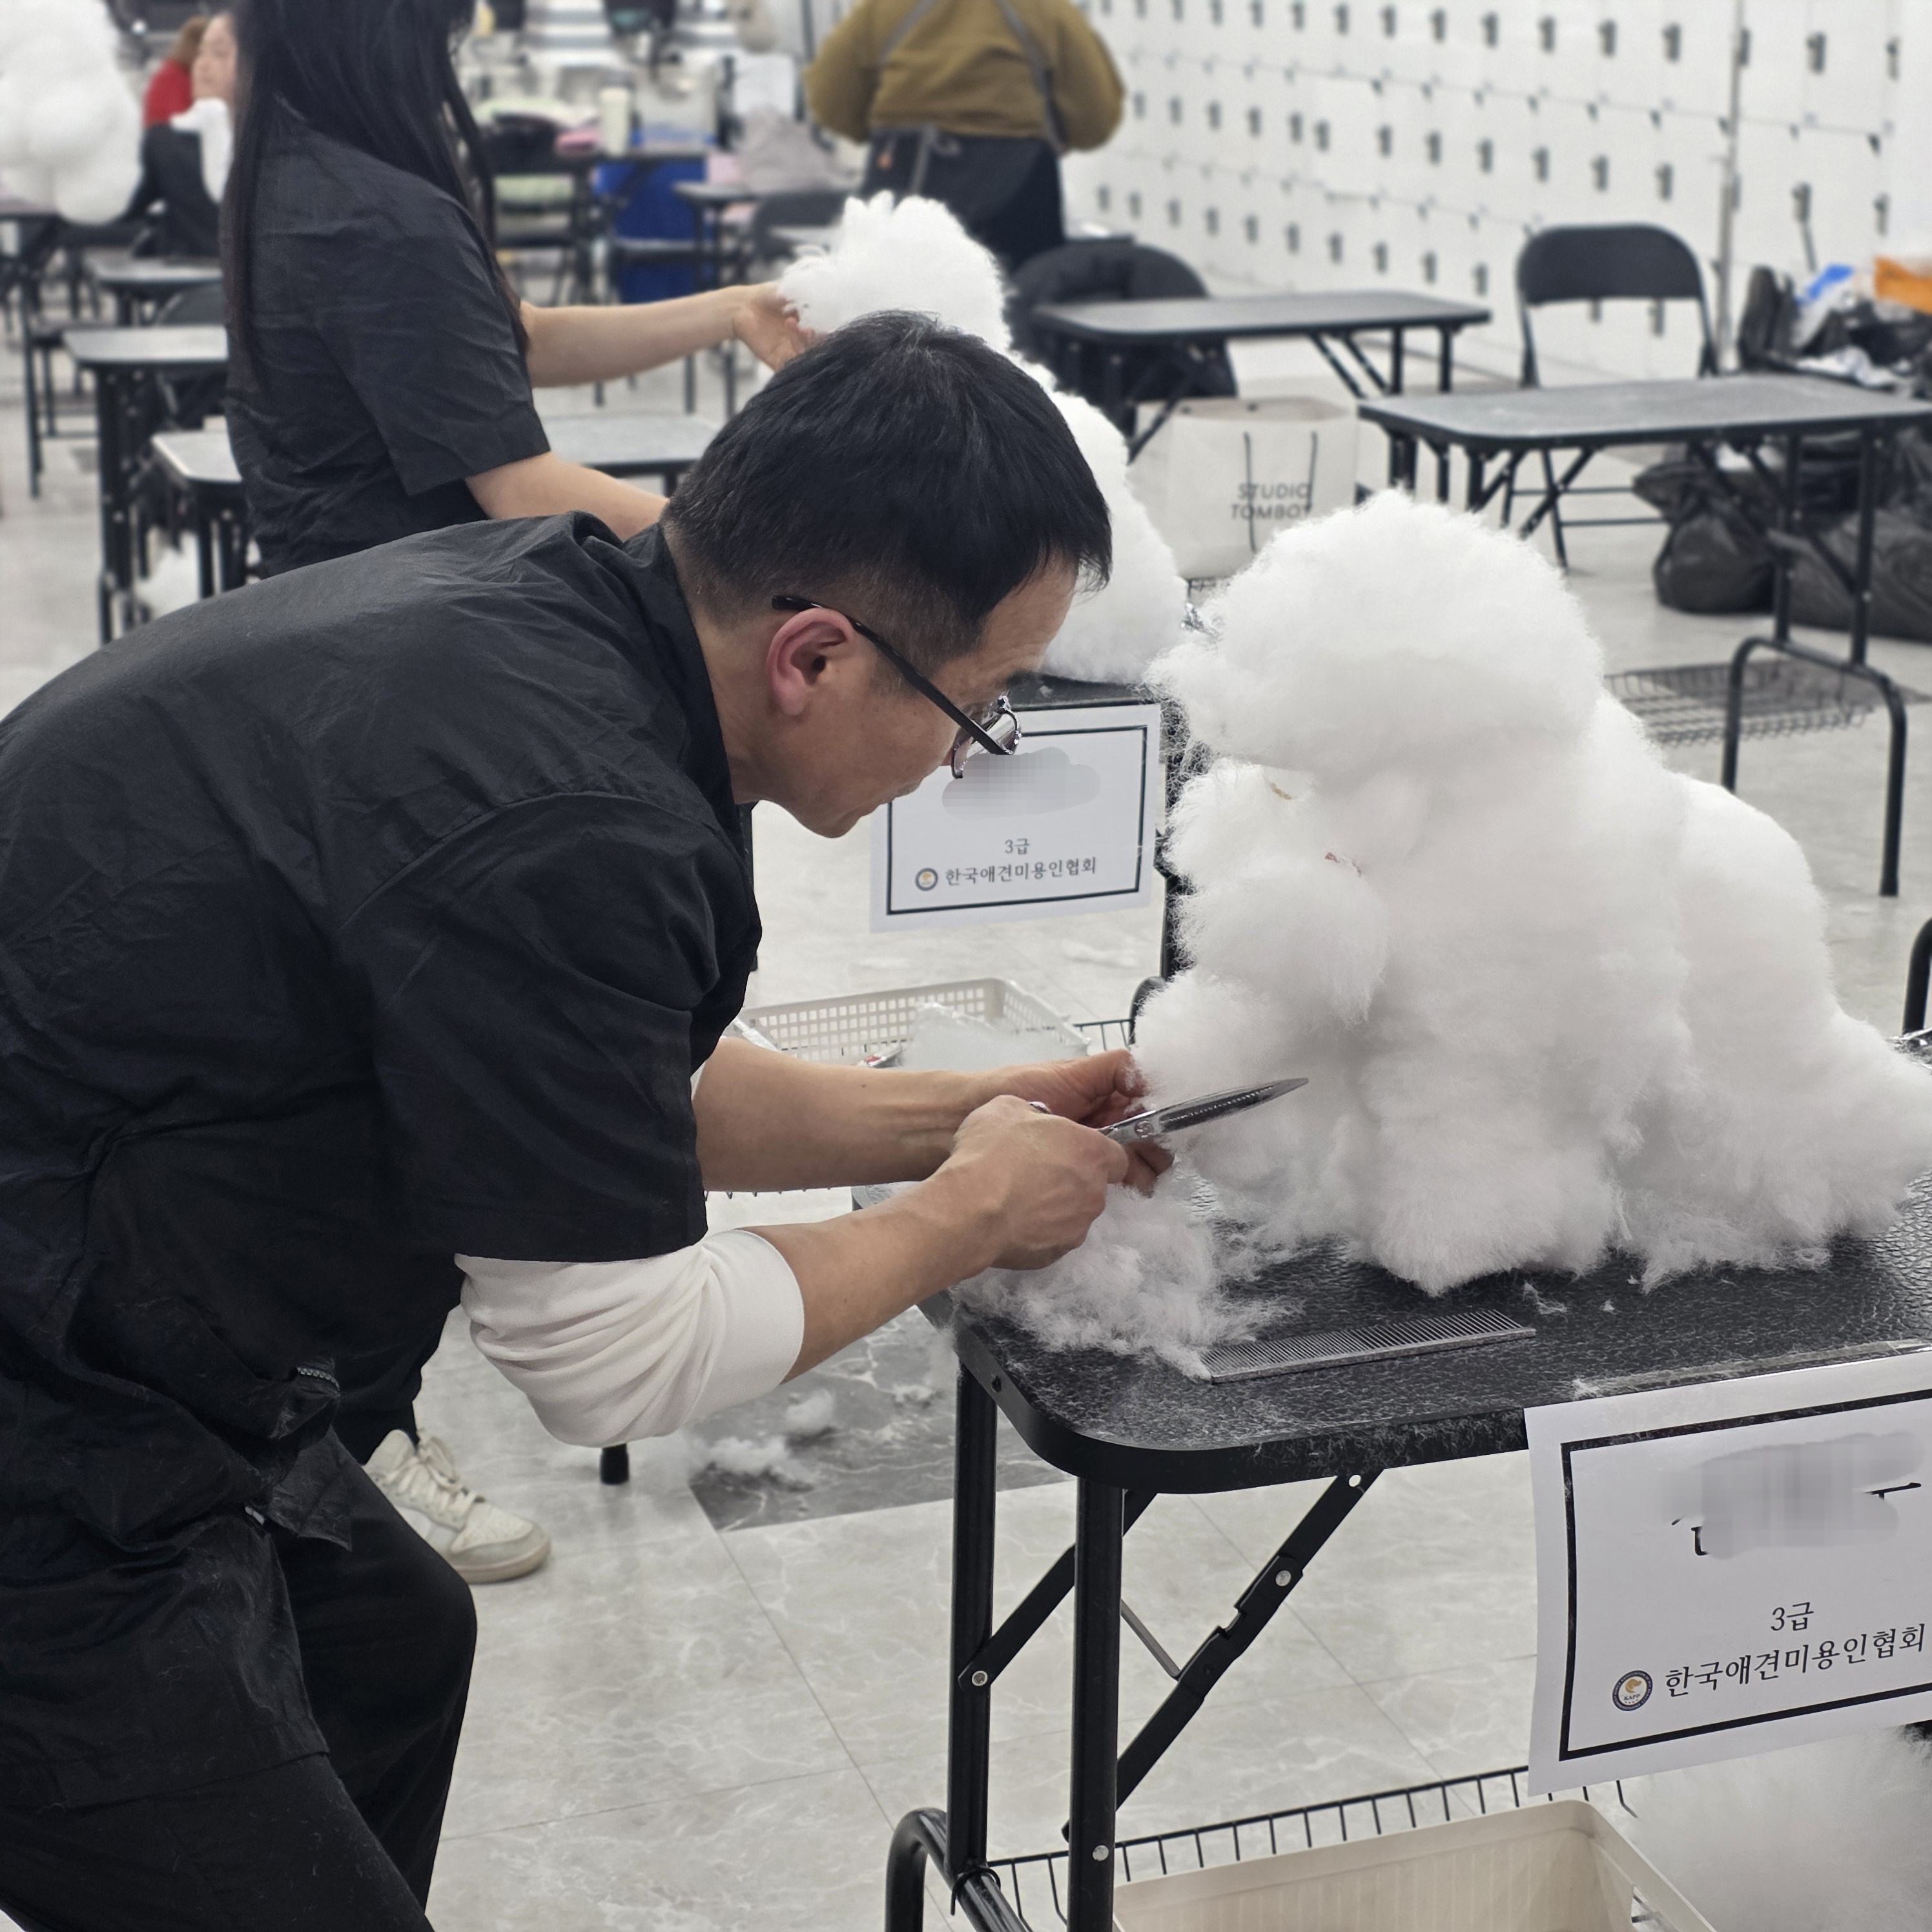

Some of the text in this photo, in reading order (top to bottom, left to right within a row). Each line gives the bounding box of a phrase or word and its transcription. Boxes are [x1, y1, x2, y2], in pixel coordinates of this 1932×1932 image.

[1238, 482, 1311, 499] STUDIO
[1004, 838, 1031, 856] 3급
[945, 856, 1096, 886] 한국애견미용인협회
[1770, 1601, 1814, 1632] 3급
[1665, 1623, 1926, 1698] 한국애견미용인협회
